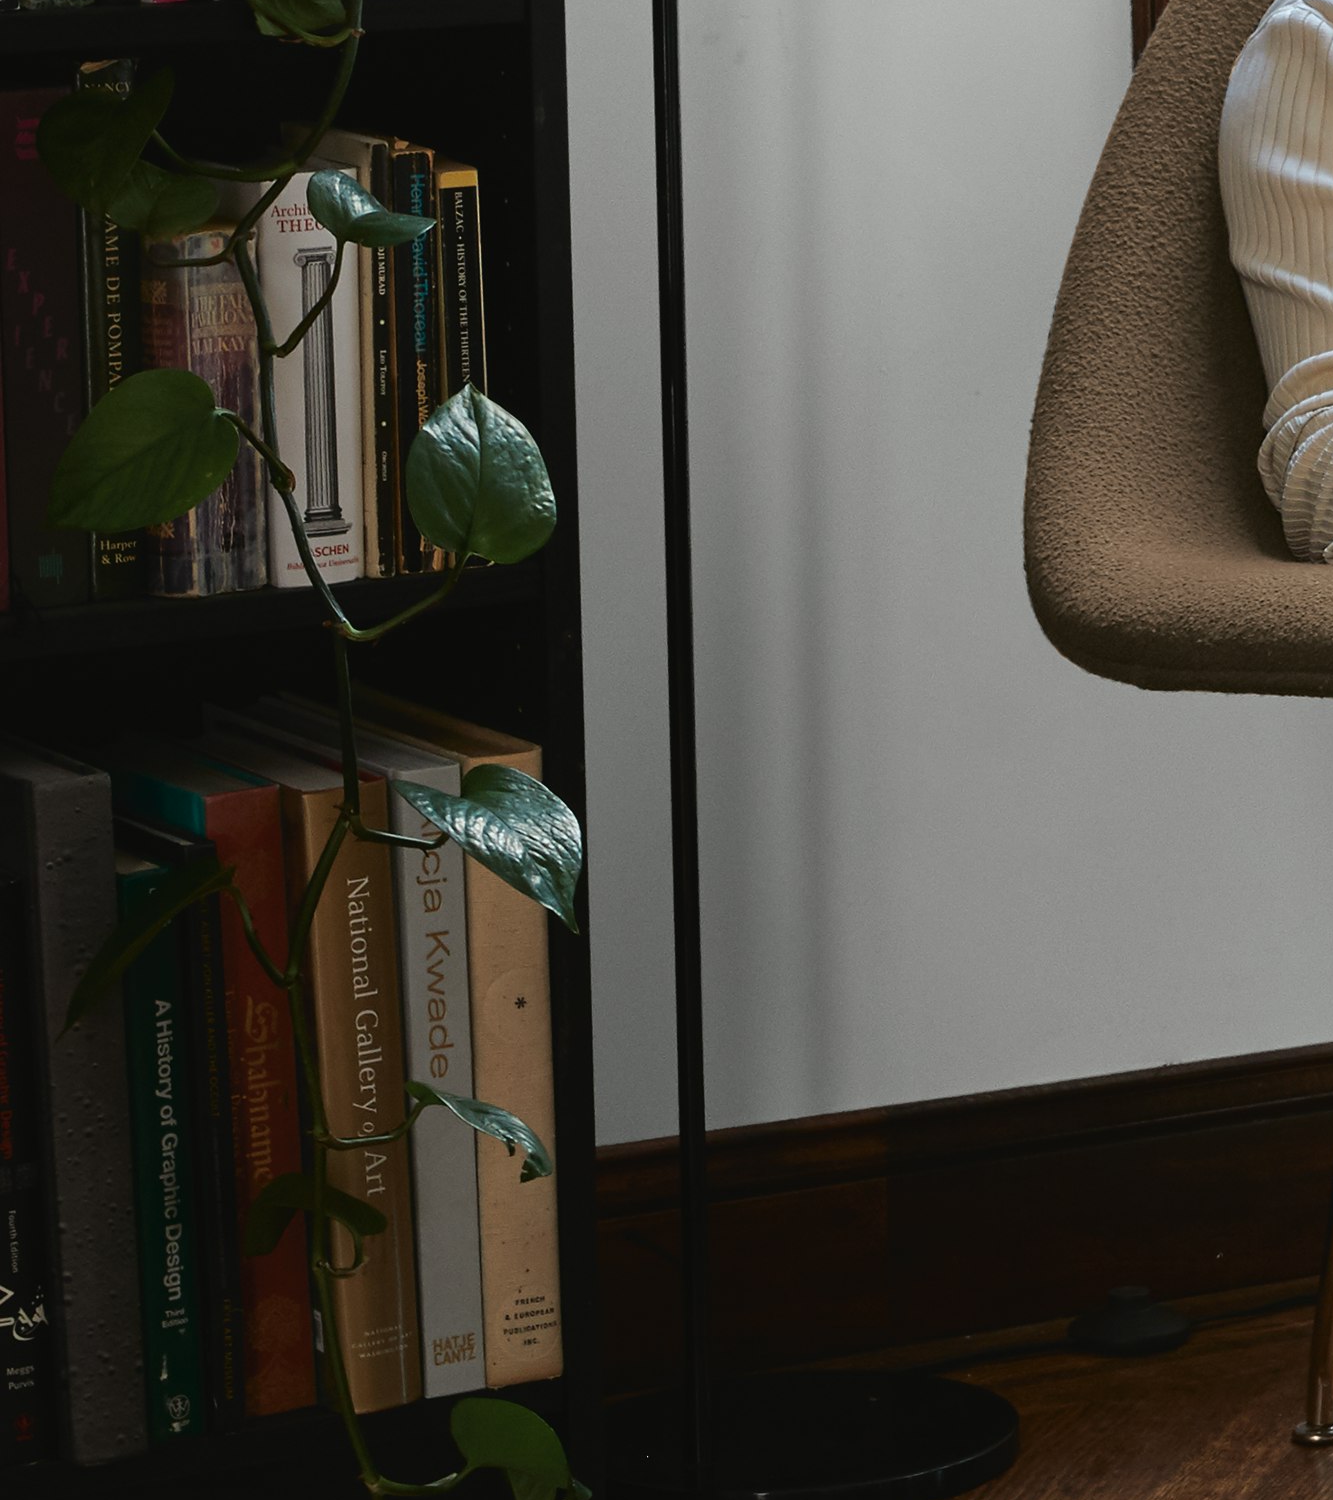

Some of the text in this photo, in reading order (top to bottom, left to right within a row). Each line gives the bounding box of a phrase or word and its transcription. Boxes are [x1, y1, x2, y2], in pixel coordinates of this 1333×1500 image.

[409, 173, 427, 217] Henr
[453, 191, 465, 234] BALZAC
[376, 261, 388, 297] MURAD
[106, 276, 123, 392] DE POMPA
[413, 279, 430, 352] Thoreau
[456, 243, 471, 384] HISTORY OF THE THIRTEEN
[415, 359, 429, 404] Joseph
[99, 539, 138, 552] Harper
[100, 552, 137, 566] & Row
[346, 875, 379, 1001] National
[425, 929, 455, 1080] Kwade
[352, 1008, 384, 1115] Gallery
[243, 994, 282, 1182] Shahname
[0, 1109, 15, 1161] Design
[154, 999, 185, 1302] A History of Graphic Design
[363, 1150, 389, 1198] Art
[7, 1208, 21, 1274] Fourth Edition
[161, 1317, 190, 1329] Edition
[163, 1307, 186, 1318] Third
[502, 1320, 559, 1336] PUBLICATIONS
[513, 1307, 556, 1321] EUROPEAN
[432, 1331, 477, 1353] HATJE
[433, 1347, 478, 1367] CANTZ
